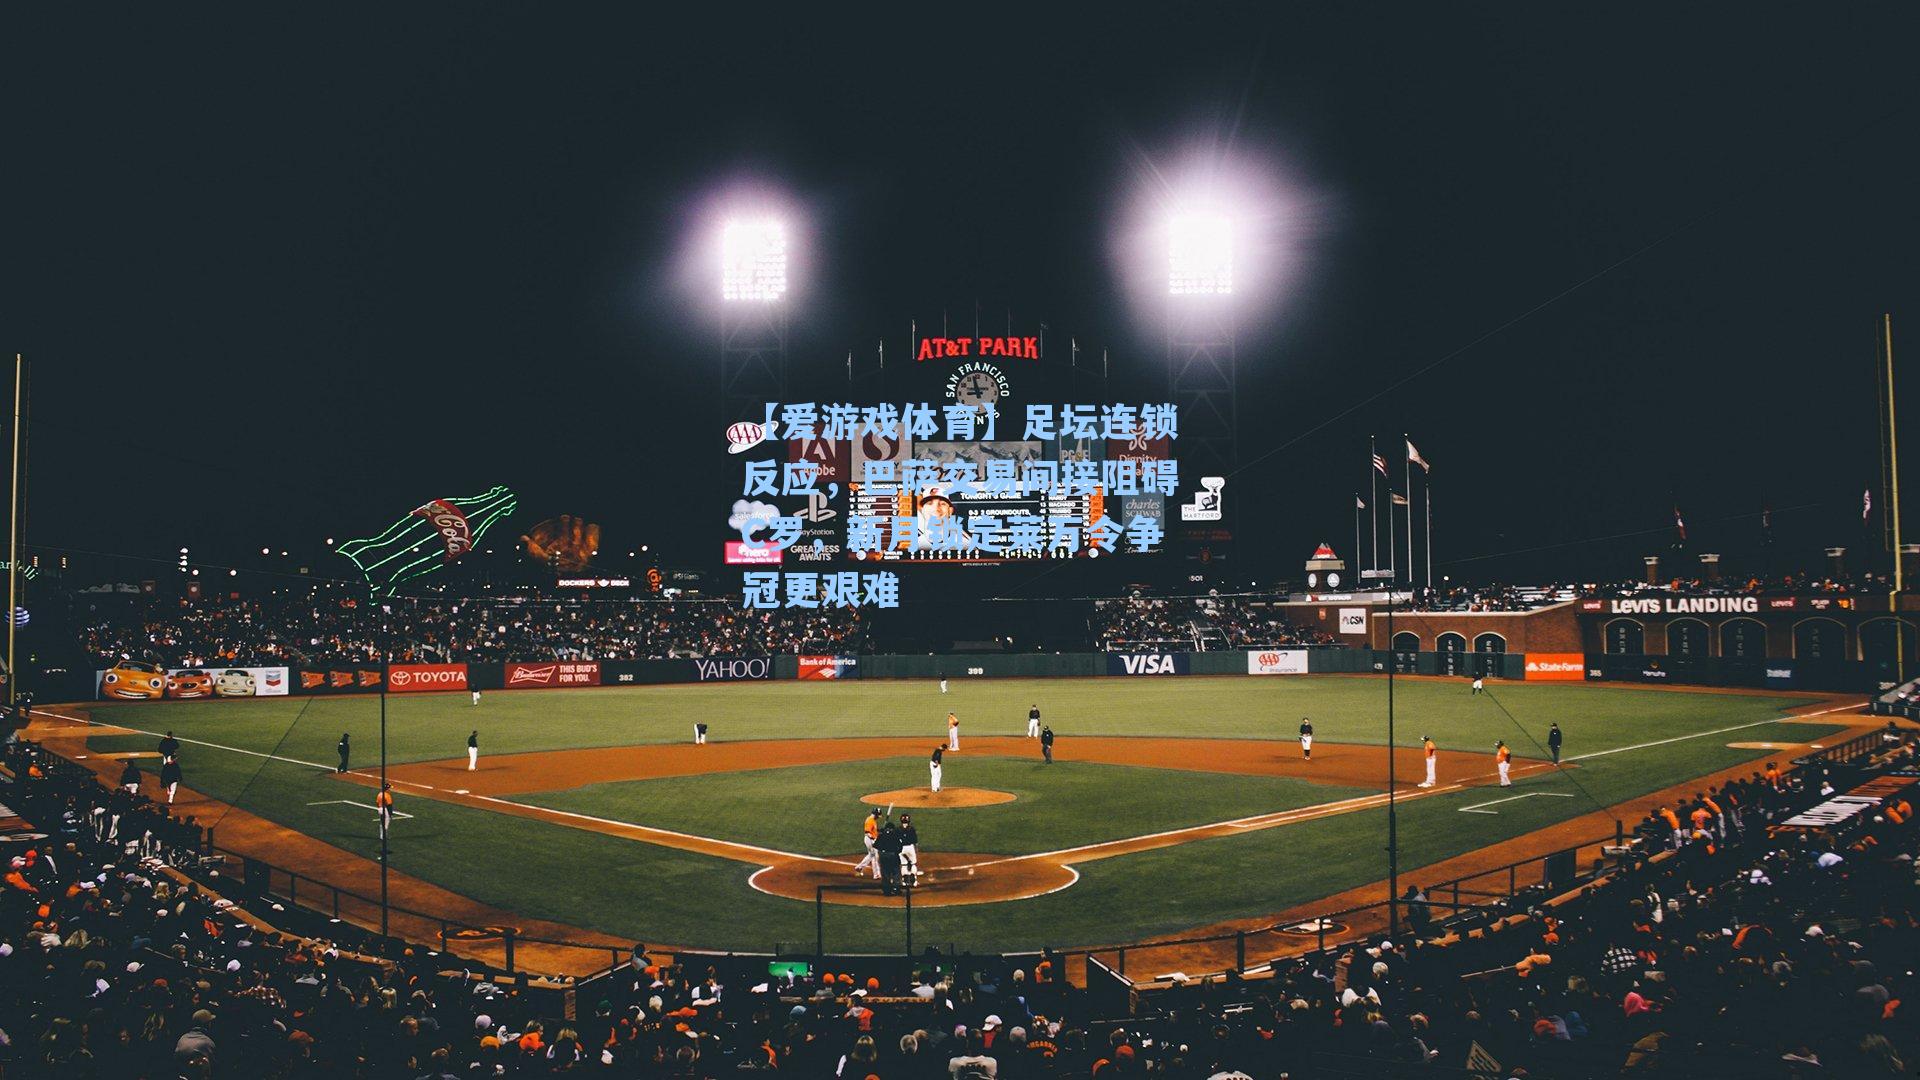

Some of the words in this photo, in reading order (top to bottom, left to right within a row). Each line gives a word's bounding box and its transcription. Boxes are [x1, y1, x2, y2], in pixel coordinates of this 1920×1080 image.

[917, 337, 972, 360] AT&T
[979, 336, 1038, 359] PARK
[946, 374, 960, 397] SAN
[958, 361, 1010, 397] FRANCISCO
[1125, 499, 1160, 510] charles
[434, 514, 472, 558] Cola
[1665, 597, 1758, 613] LANDING
[560, 665, 575, 673] THIS
[577, 664, 597, 673] BUD'S
[696, 659, 770, 681] YAHOO!
[800, 658, 818, 666] Bank
[827, 658, 856, 666] America
[1119, 655, 1175, 674] VISA
[413, 671, 466, 683] TOYOTA
[560, 674, 573, 682] FOR
[574, 674, 590, 682] YOU.
